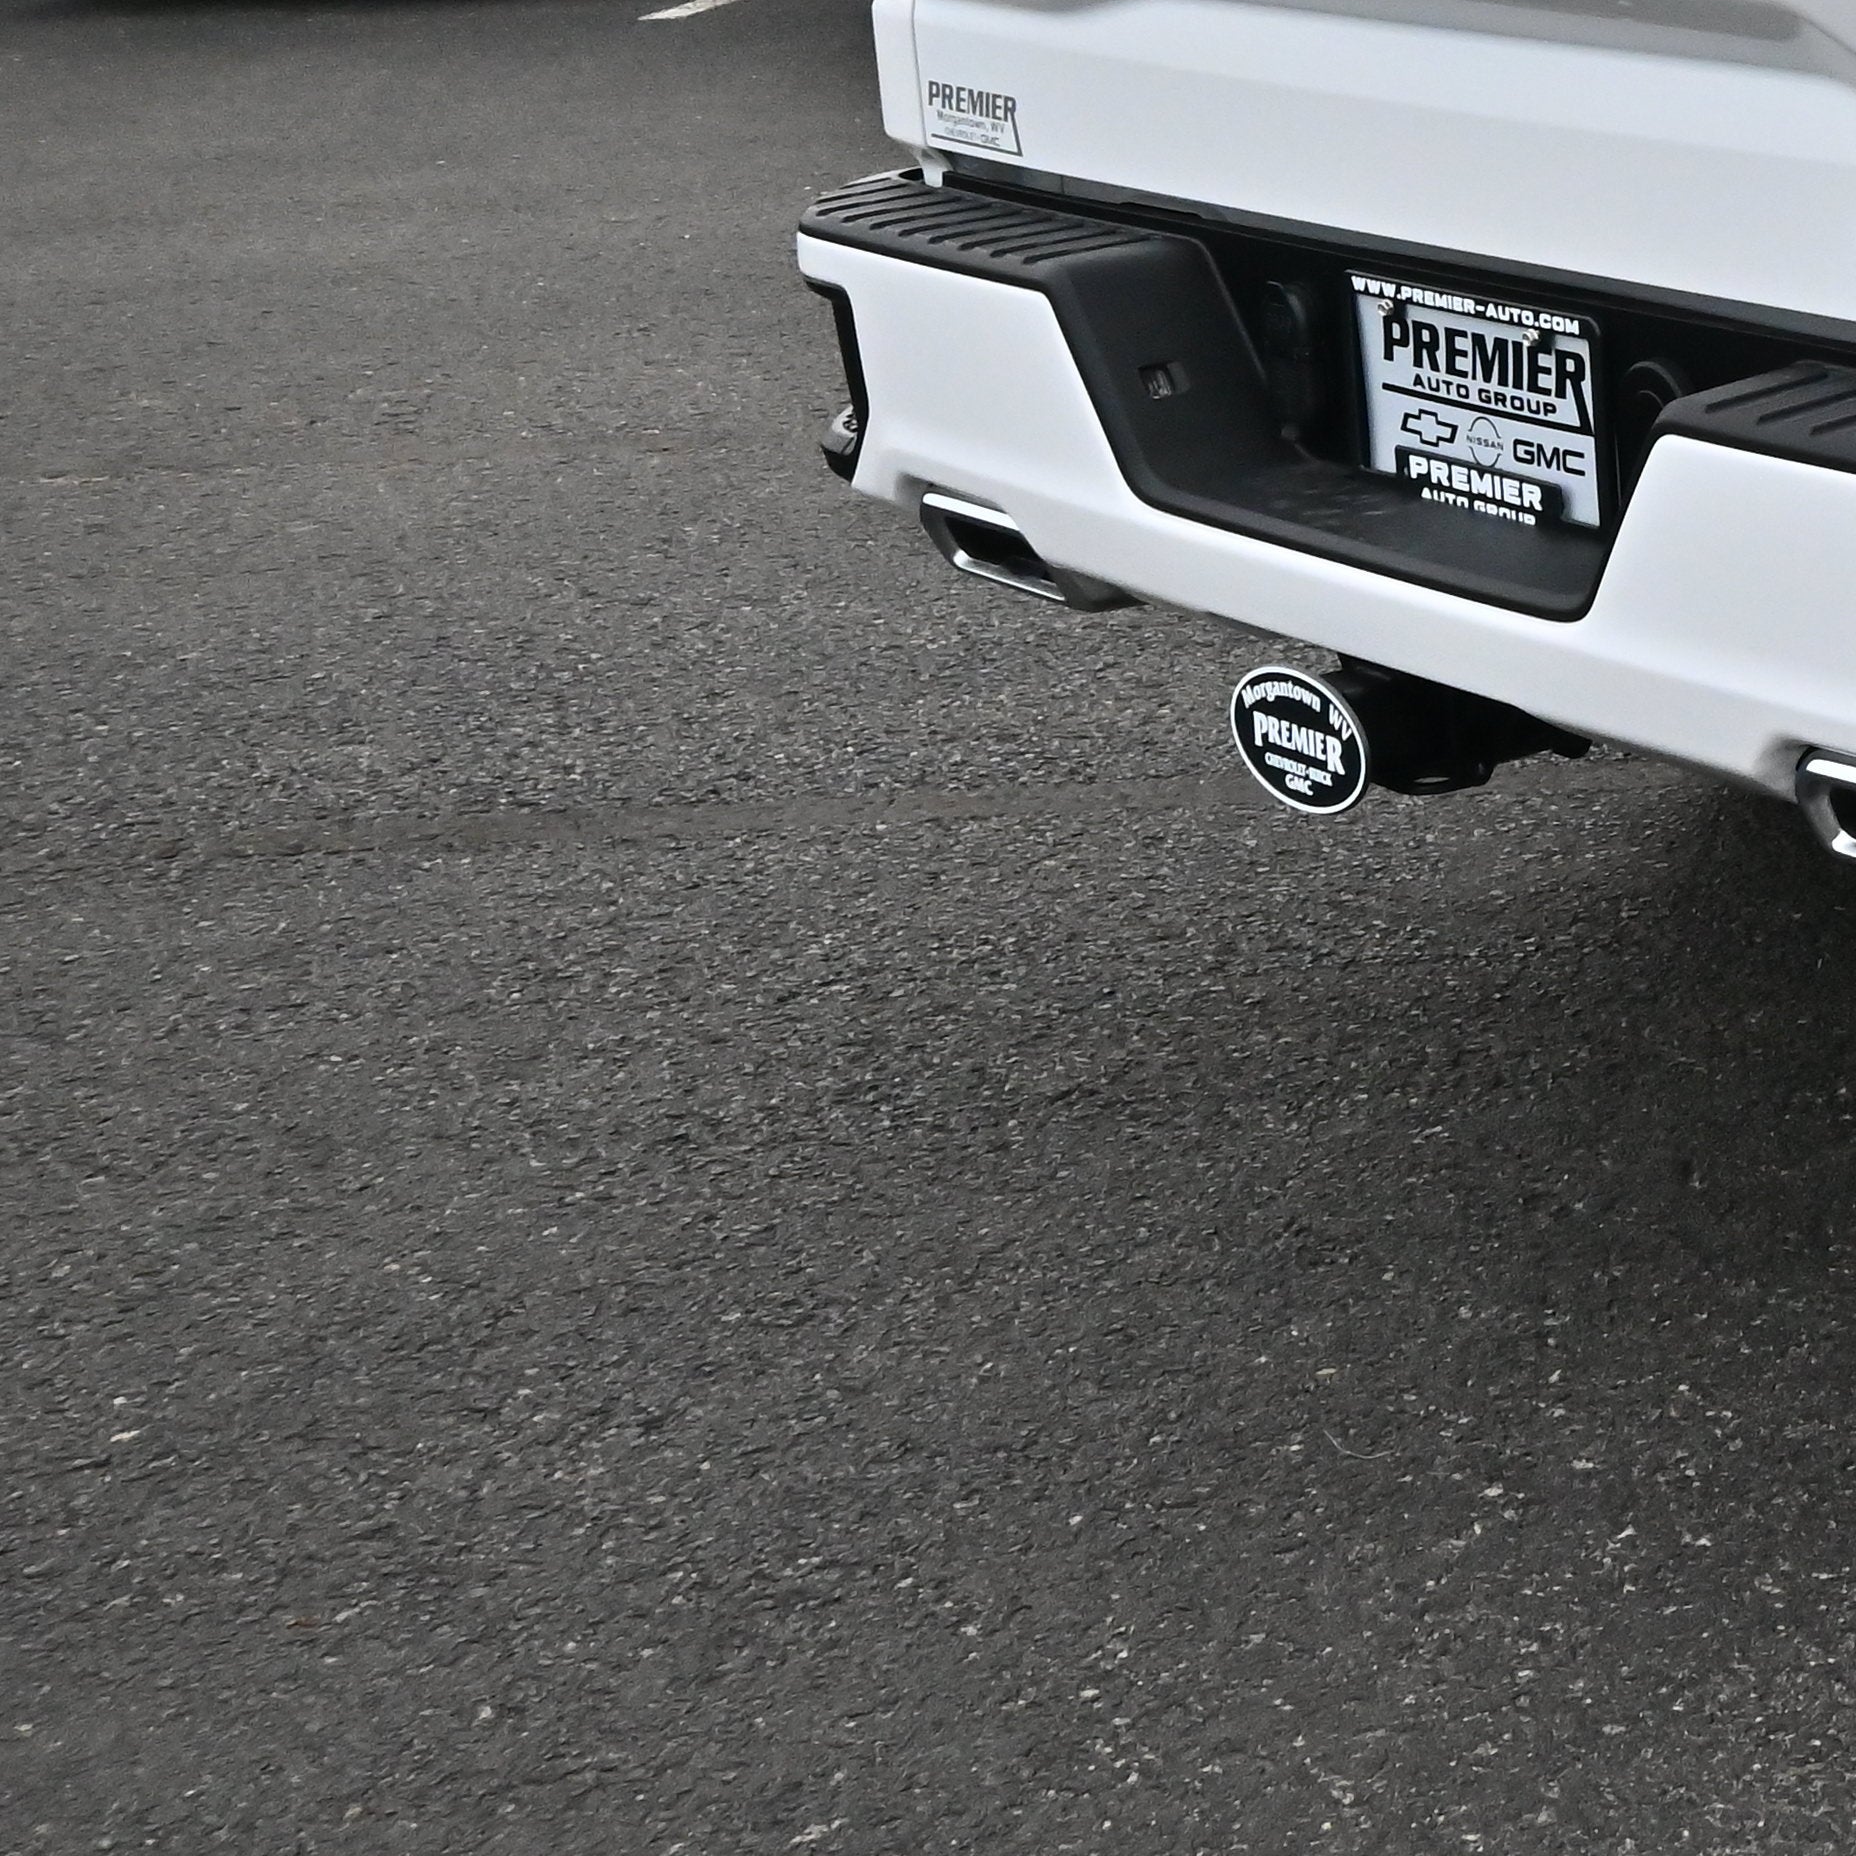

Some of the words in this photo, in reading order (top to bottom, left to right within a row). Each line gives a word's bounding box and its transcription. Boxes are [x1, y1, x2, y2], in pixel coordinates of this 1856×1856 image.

[928, 80, 1017, 123] PREMIER
[1351, 275, 1580, 335] WWW.PREMIER-AUTO.COM
[1382, 314, 1587, 401] PREMIER
[1413, 373, 1470, 400] AUTO
[1478, 388, 1557, 417] GROUP
[1466, 433, 1504, 451] NISSAN
[1513, 438, 1586, 477] GMC
[1408, 454, 1543, 512] PREMIER
[1241, 680, 1321, 713] Morgantown
[1328, 703, 1353, 742] WV
[1253, 710, 1346, 776] PREMIER
[1284, 773, 1314, 796] GMC
